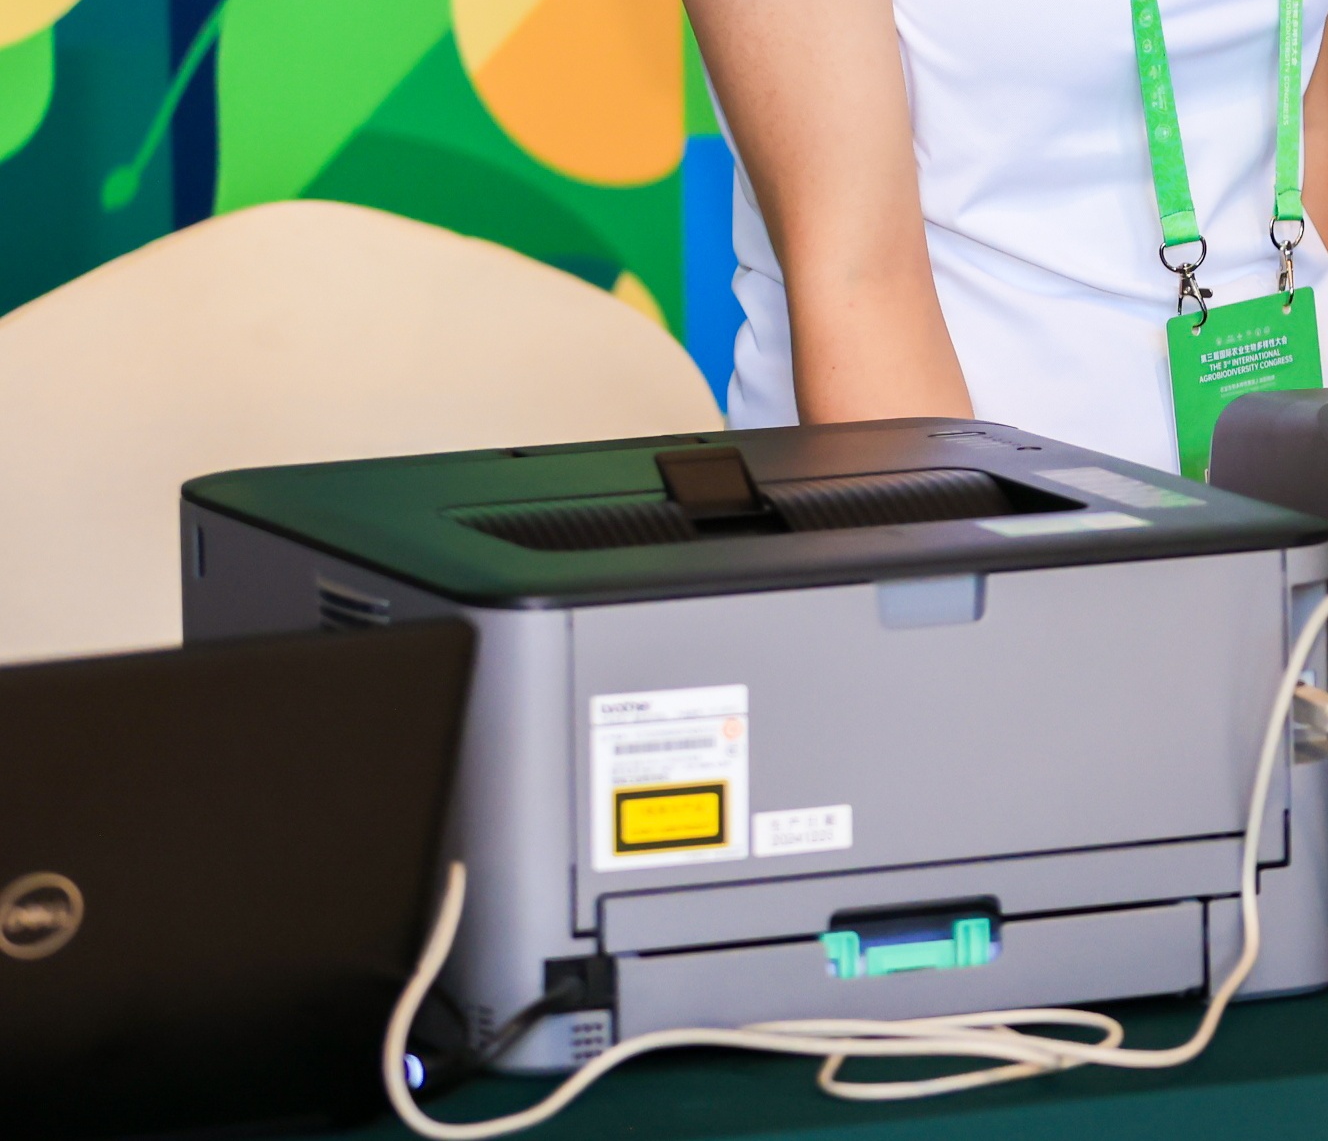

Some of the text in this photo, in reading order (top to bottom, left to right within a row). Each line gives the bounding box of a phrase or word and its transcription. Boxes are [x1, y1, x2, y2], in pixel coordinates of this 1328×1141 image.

[1200, 335, 1288, 364] 第三届国际农业生物多样性大会
[1209, 362, 1222, 372] THE
[1231, 348, 1281, 367] INTERNATIONAL
[1198, 354, 1294, 384] AGROBIODIVERSITY CONGRESS
